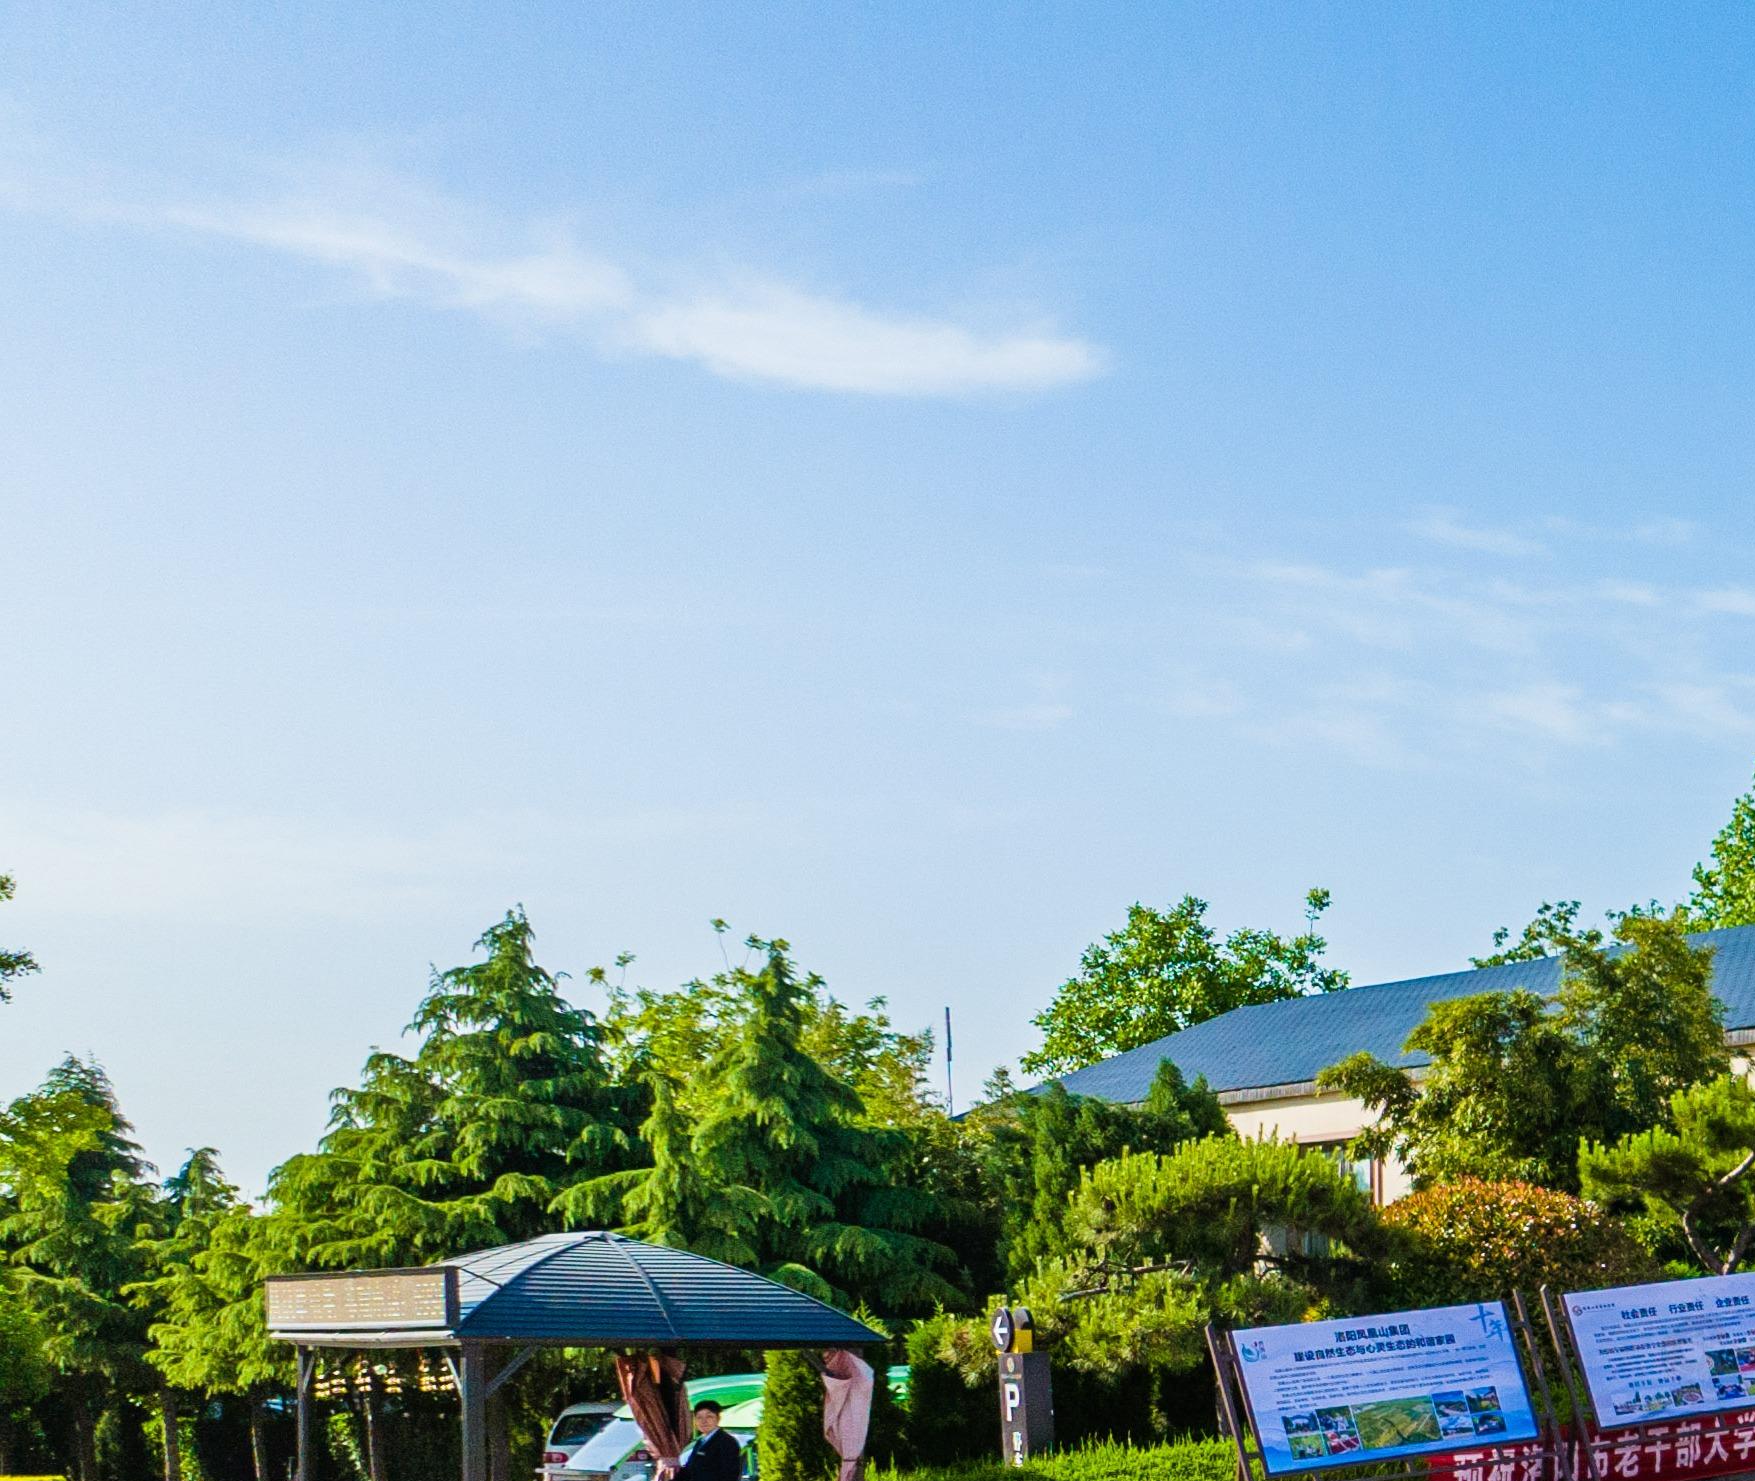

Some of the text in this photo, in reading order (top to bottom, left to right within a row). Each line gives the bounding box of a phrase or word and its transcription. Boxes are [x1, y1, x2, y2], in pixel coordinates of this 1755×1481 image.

[1621, 1307, 1658, 1321] 社会责任
[1668, 1300, 1705, 1315] 行业责任
[1715, 1294, 1751, 1309] 企业责任
[1334, 1323, 1412, 1344] 洛阳凤凰山集团
[1293, 1333, 1457, 1363] 建设自然生态与心灵生态的和谐家园
[1004, 1383, 1020, 1422] P
